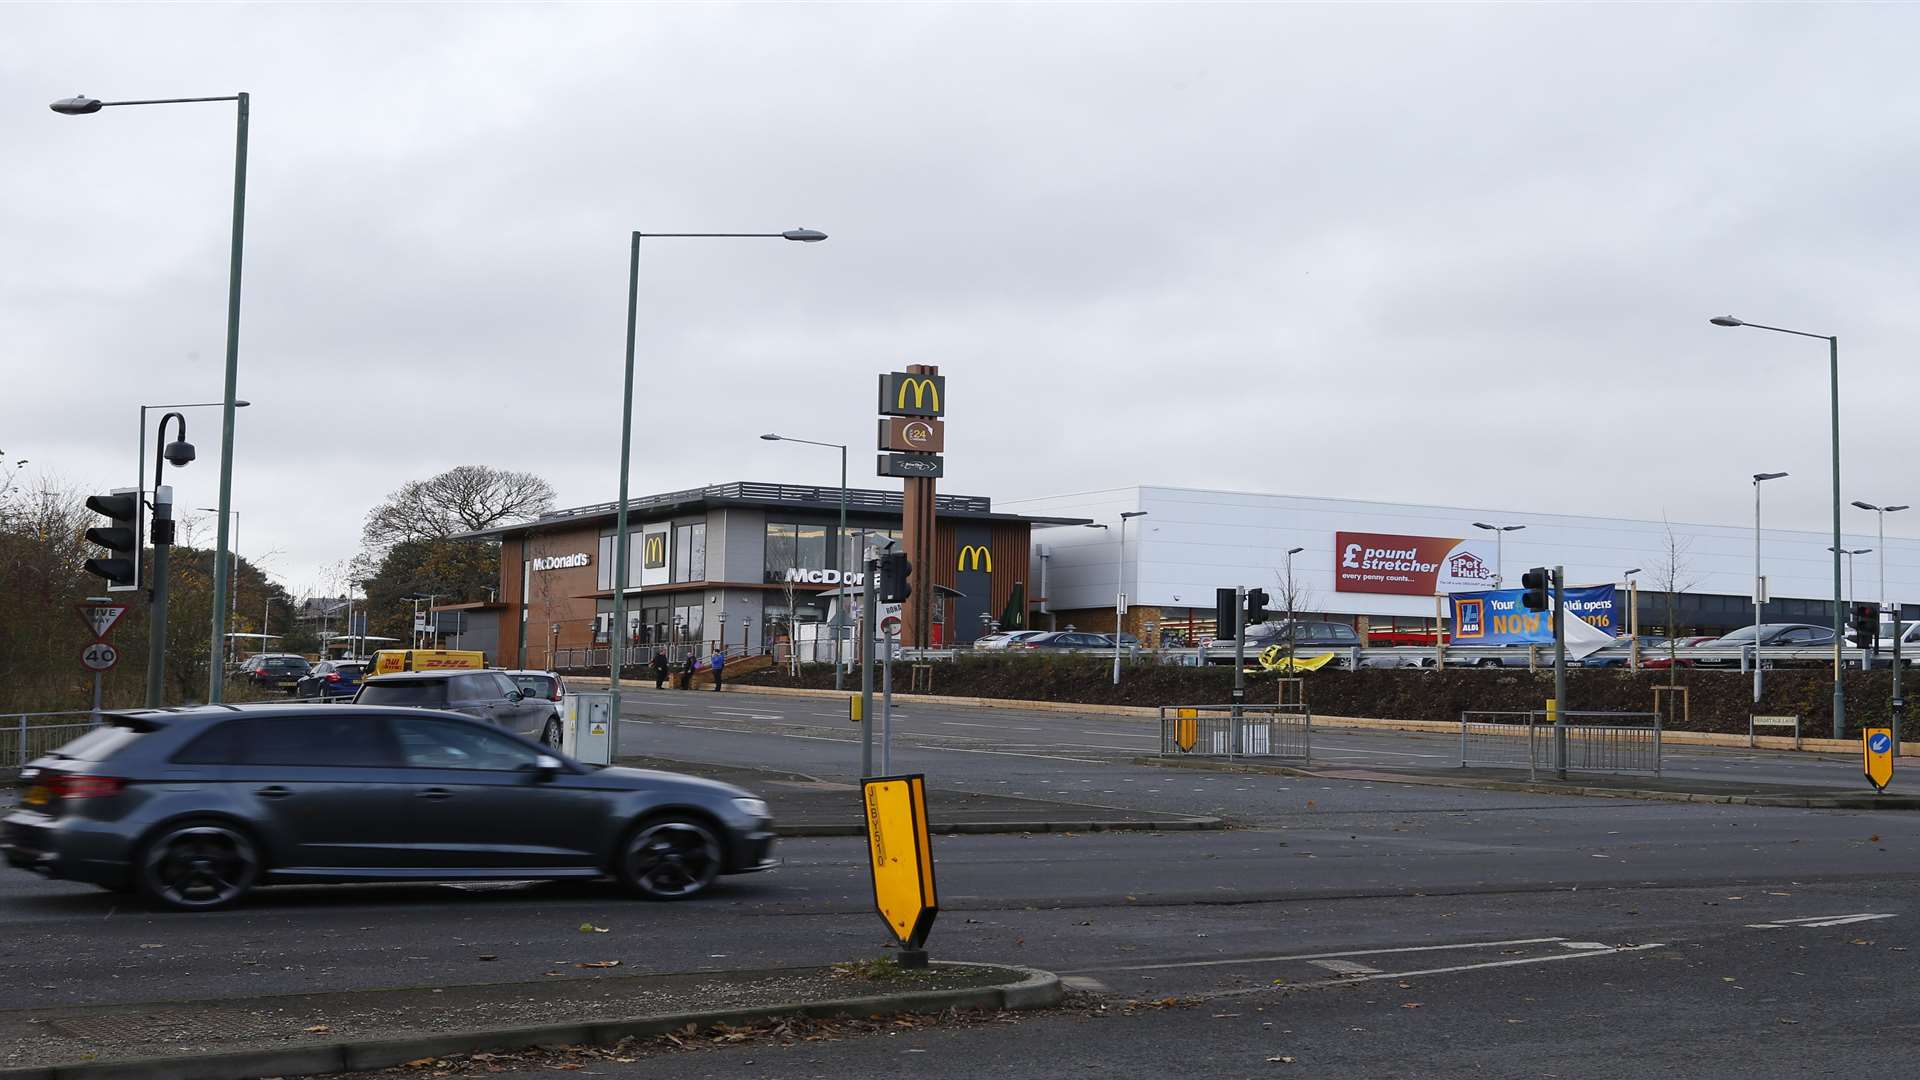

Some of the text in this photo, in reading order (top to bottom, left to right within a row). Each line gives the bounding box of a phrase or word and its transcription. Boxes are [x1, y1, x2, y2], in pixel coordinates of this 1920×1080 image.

[914, 429, 926, 438] 24
[1364, 548, 1417, 560] pound
[533, 553, 588, 571] McDonald's
[1361, 558, 1438, 573] stretcher
[1459, 558, 1479, 568] Pet
[1459, 567, 1479, 577] Hut
[1342, 572, 1361, 580] every
[1363, 573, 1385, 583] penny
[1491, 600, 1515, 610] Your
[1563, 600, 1612, 612] Aldi opens
[87, 608, 117, 617] GIVE
[1462, 624, 1479, 632] ALDI
[1493, 614, 1540, 634] NOW
[86, 650, 115, 662] 40
[426, 659, 470, 668] DHL
